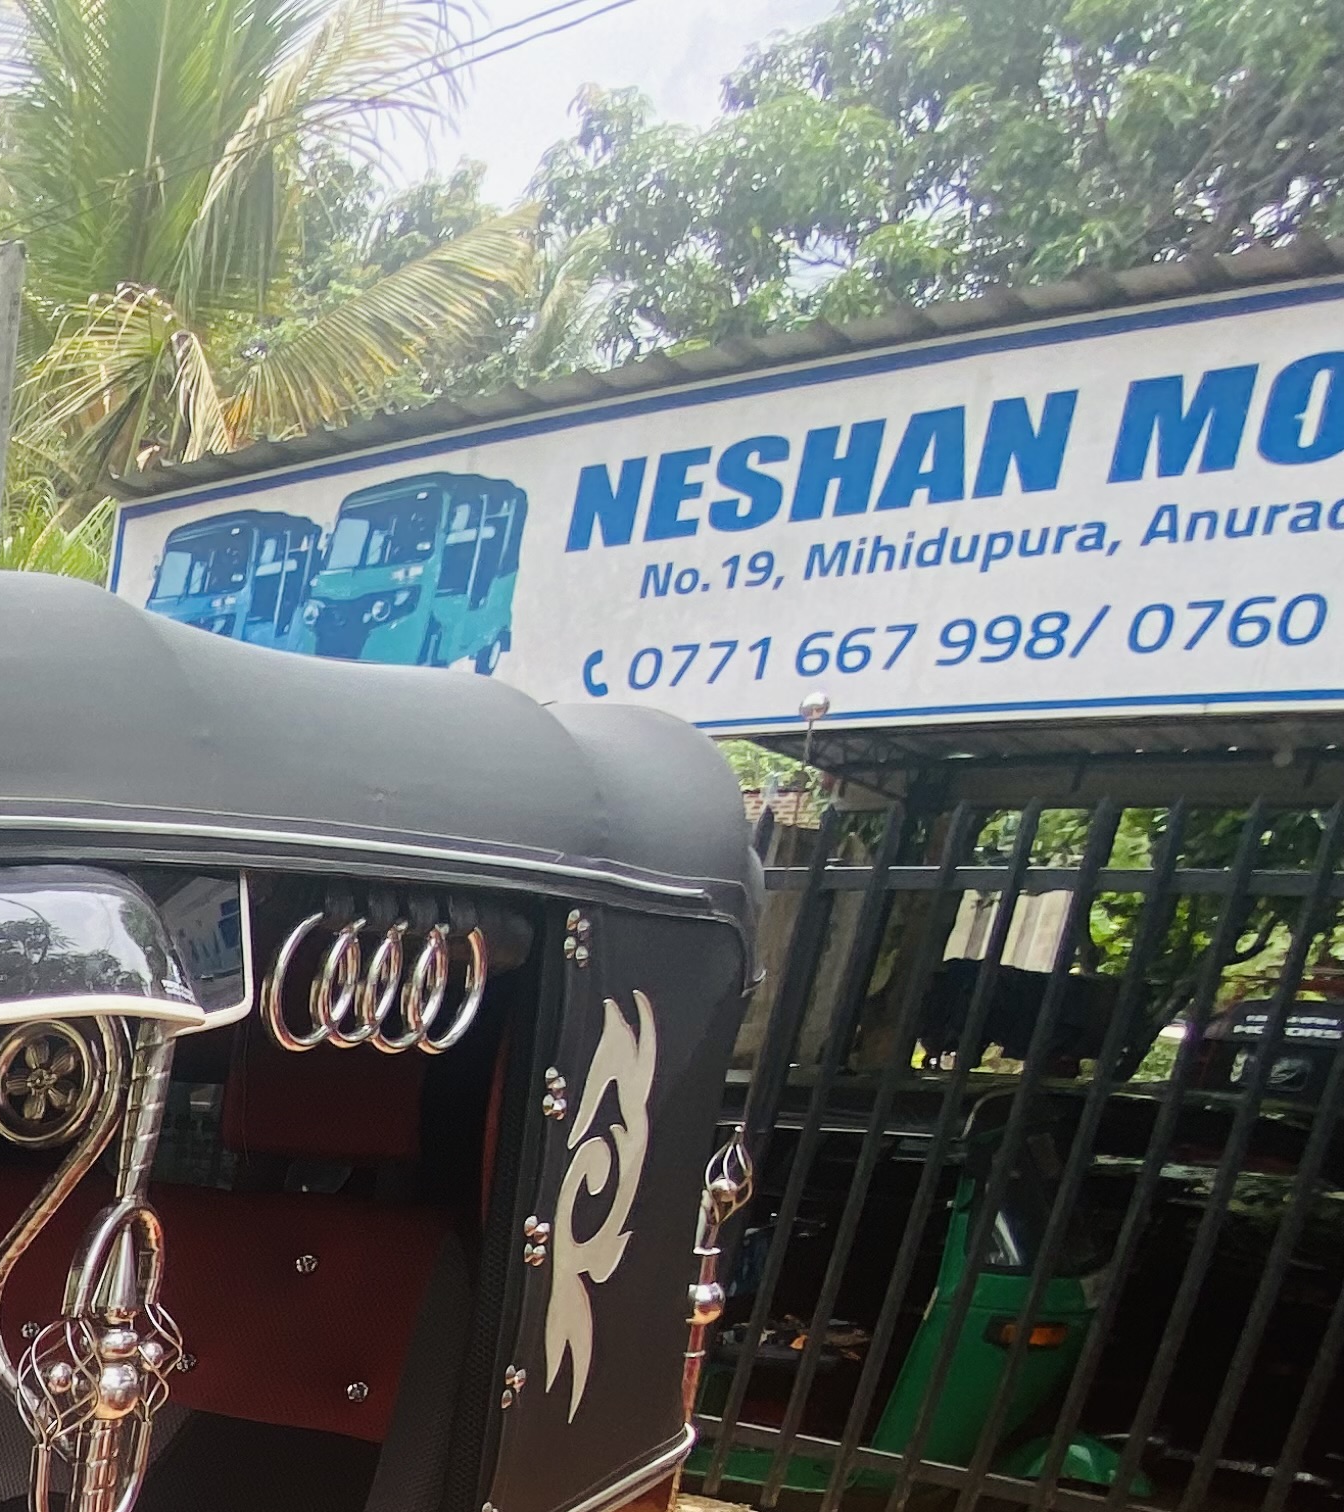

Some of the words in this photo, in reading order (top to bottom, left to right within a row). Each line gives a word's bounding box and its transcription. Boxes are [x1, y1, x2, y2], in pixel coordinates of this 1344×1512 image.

[565, 389, 1079, 553] NESHAN
[803, 520, 1121, 580] Mihidupura,
[628, 636, 772, 690] 0771
[794, 623, 918, 677] 667
[1127, 592, 1328, 654] 0760
